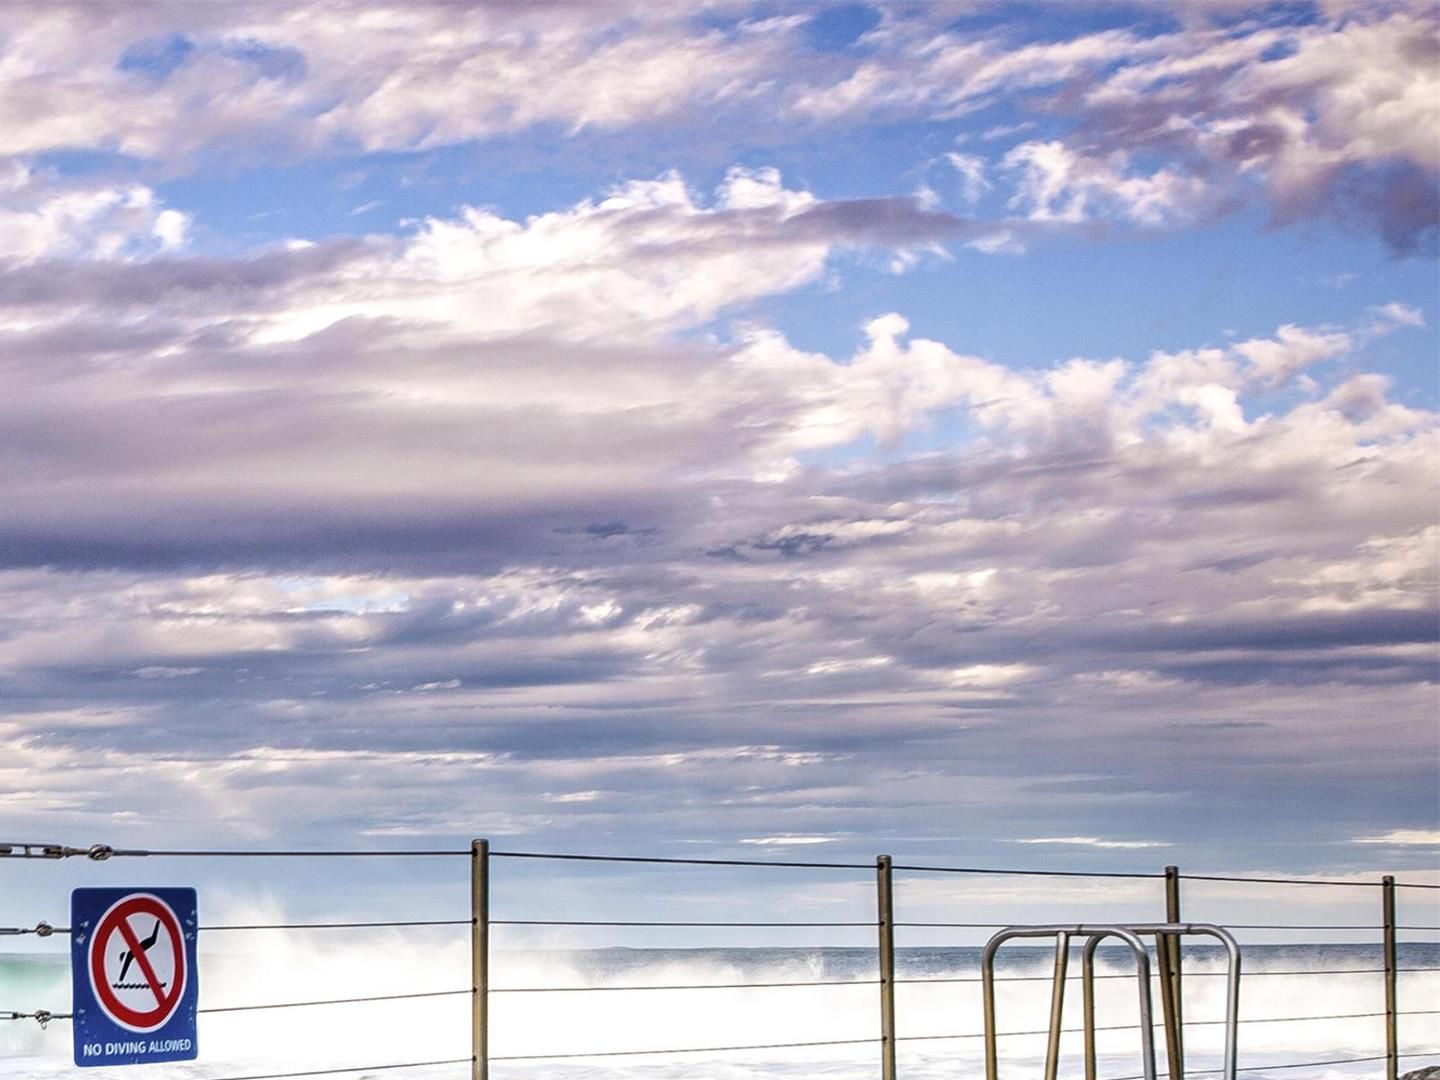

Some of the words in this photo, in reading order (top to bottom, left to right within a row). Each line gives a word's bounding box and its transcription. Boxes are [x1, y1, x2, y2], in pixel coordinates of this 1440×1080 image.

[83, 1043, 102, 1056] NO
[105, 1041, 146, 1055] DIVING
[148, 1038, 192, 1053] ALLOWED
